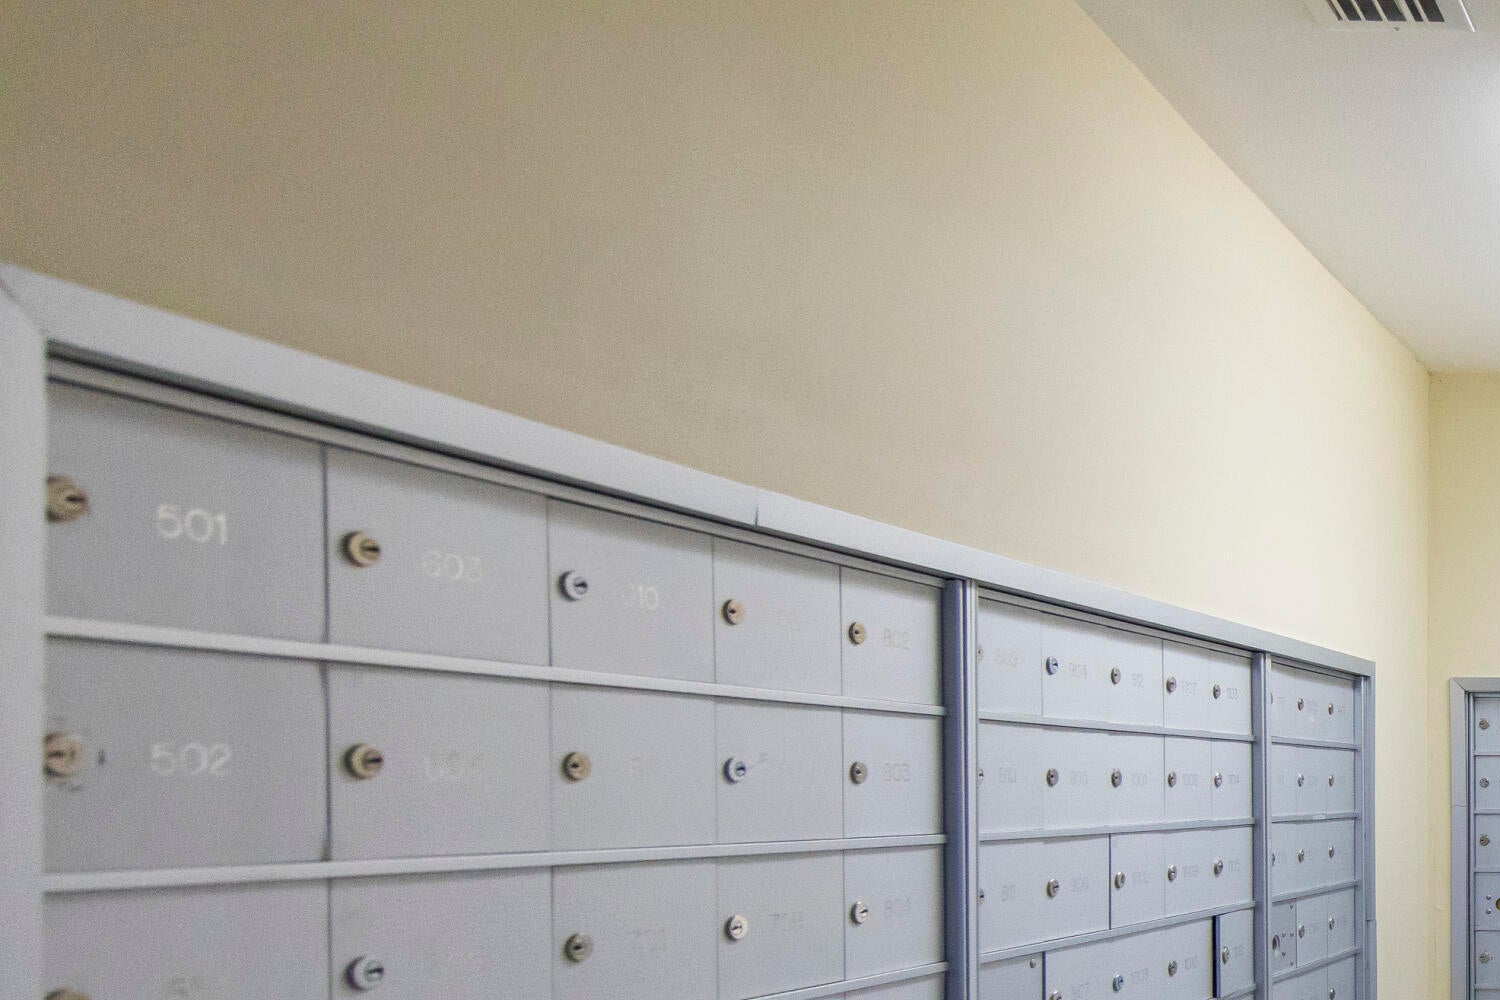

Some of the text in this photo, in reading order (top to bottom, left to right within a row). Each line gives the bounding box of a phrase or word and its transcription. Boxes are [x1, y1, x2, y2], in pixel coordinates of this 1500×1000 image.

[155, 503, 230, 545] 501
[421, 548, 483, 584] 603
[150, 742, 233, 778] 502
